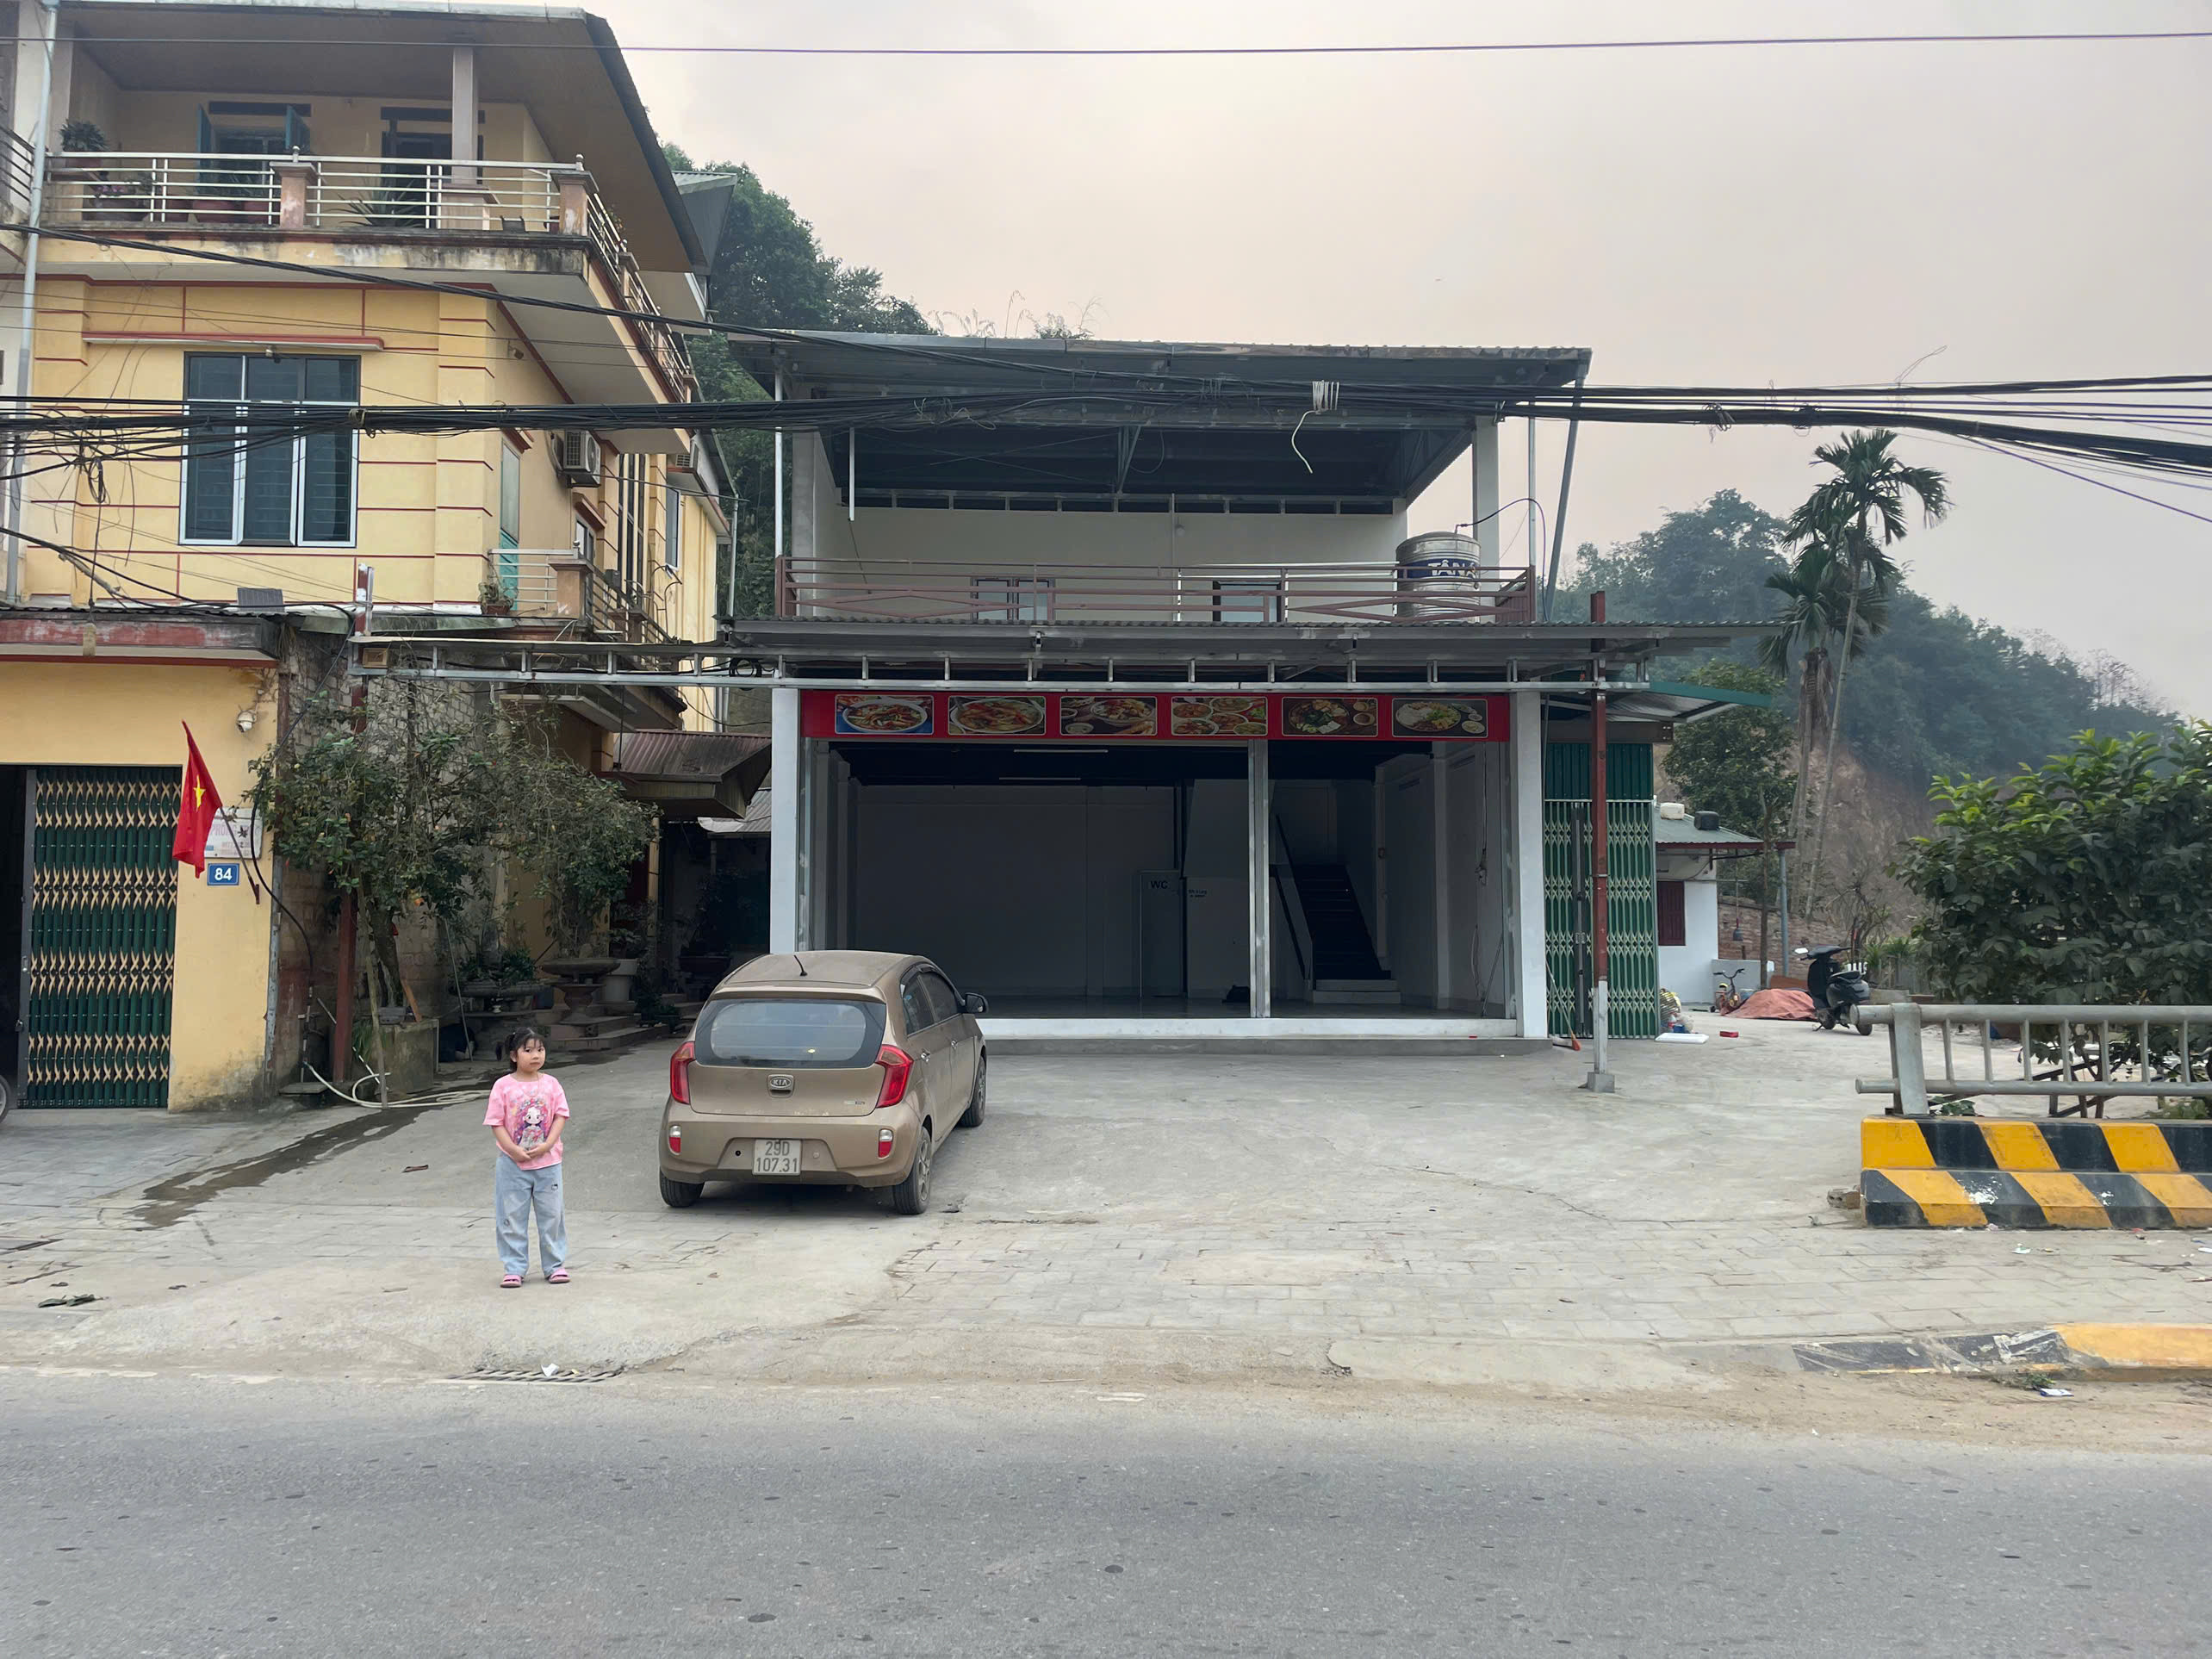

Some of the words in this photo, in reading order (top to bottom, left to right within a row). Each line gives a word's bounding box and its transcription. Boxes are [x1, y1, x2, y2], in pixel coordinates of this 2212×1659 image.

[214, 867, 233, 880] 84
[1150, 880, 1168, 890] WC
[765, 1140, 790, 1156] 29D
[756, 1157, 798, 1172] 107.31
